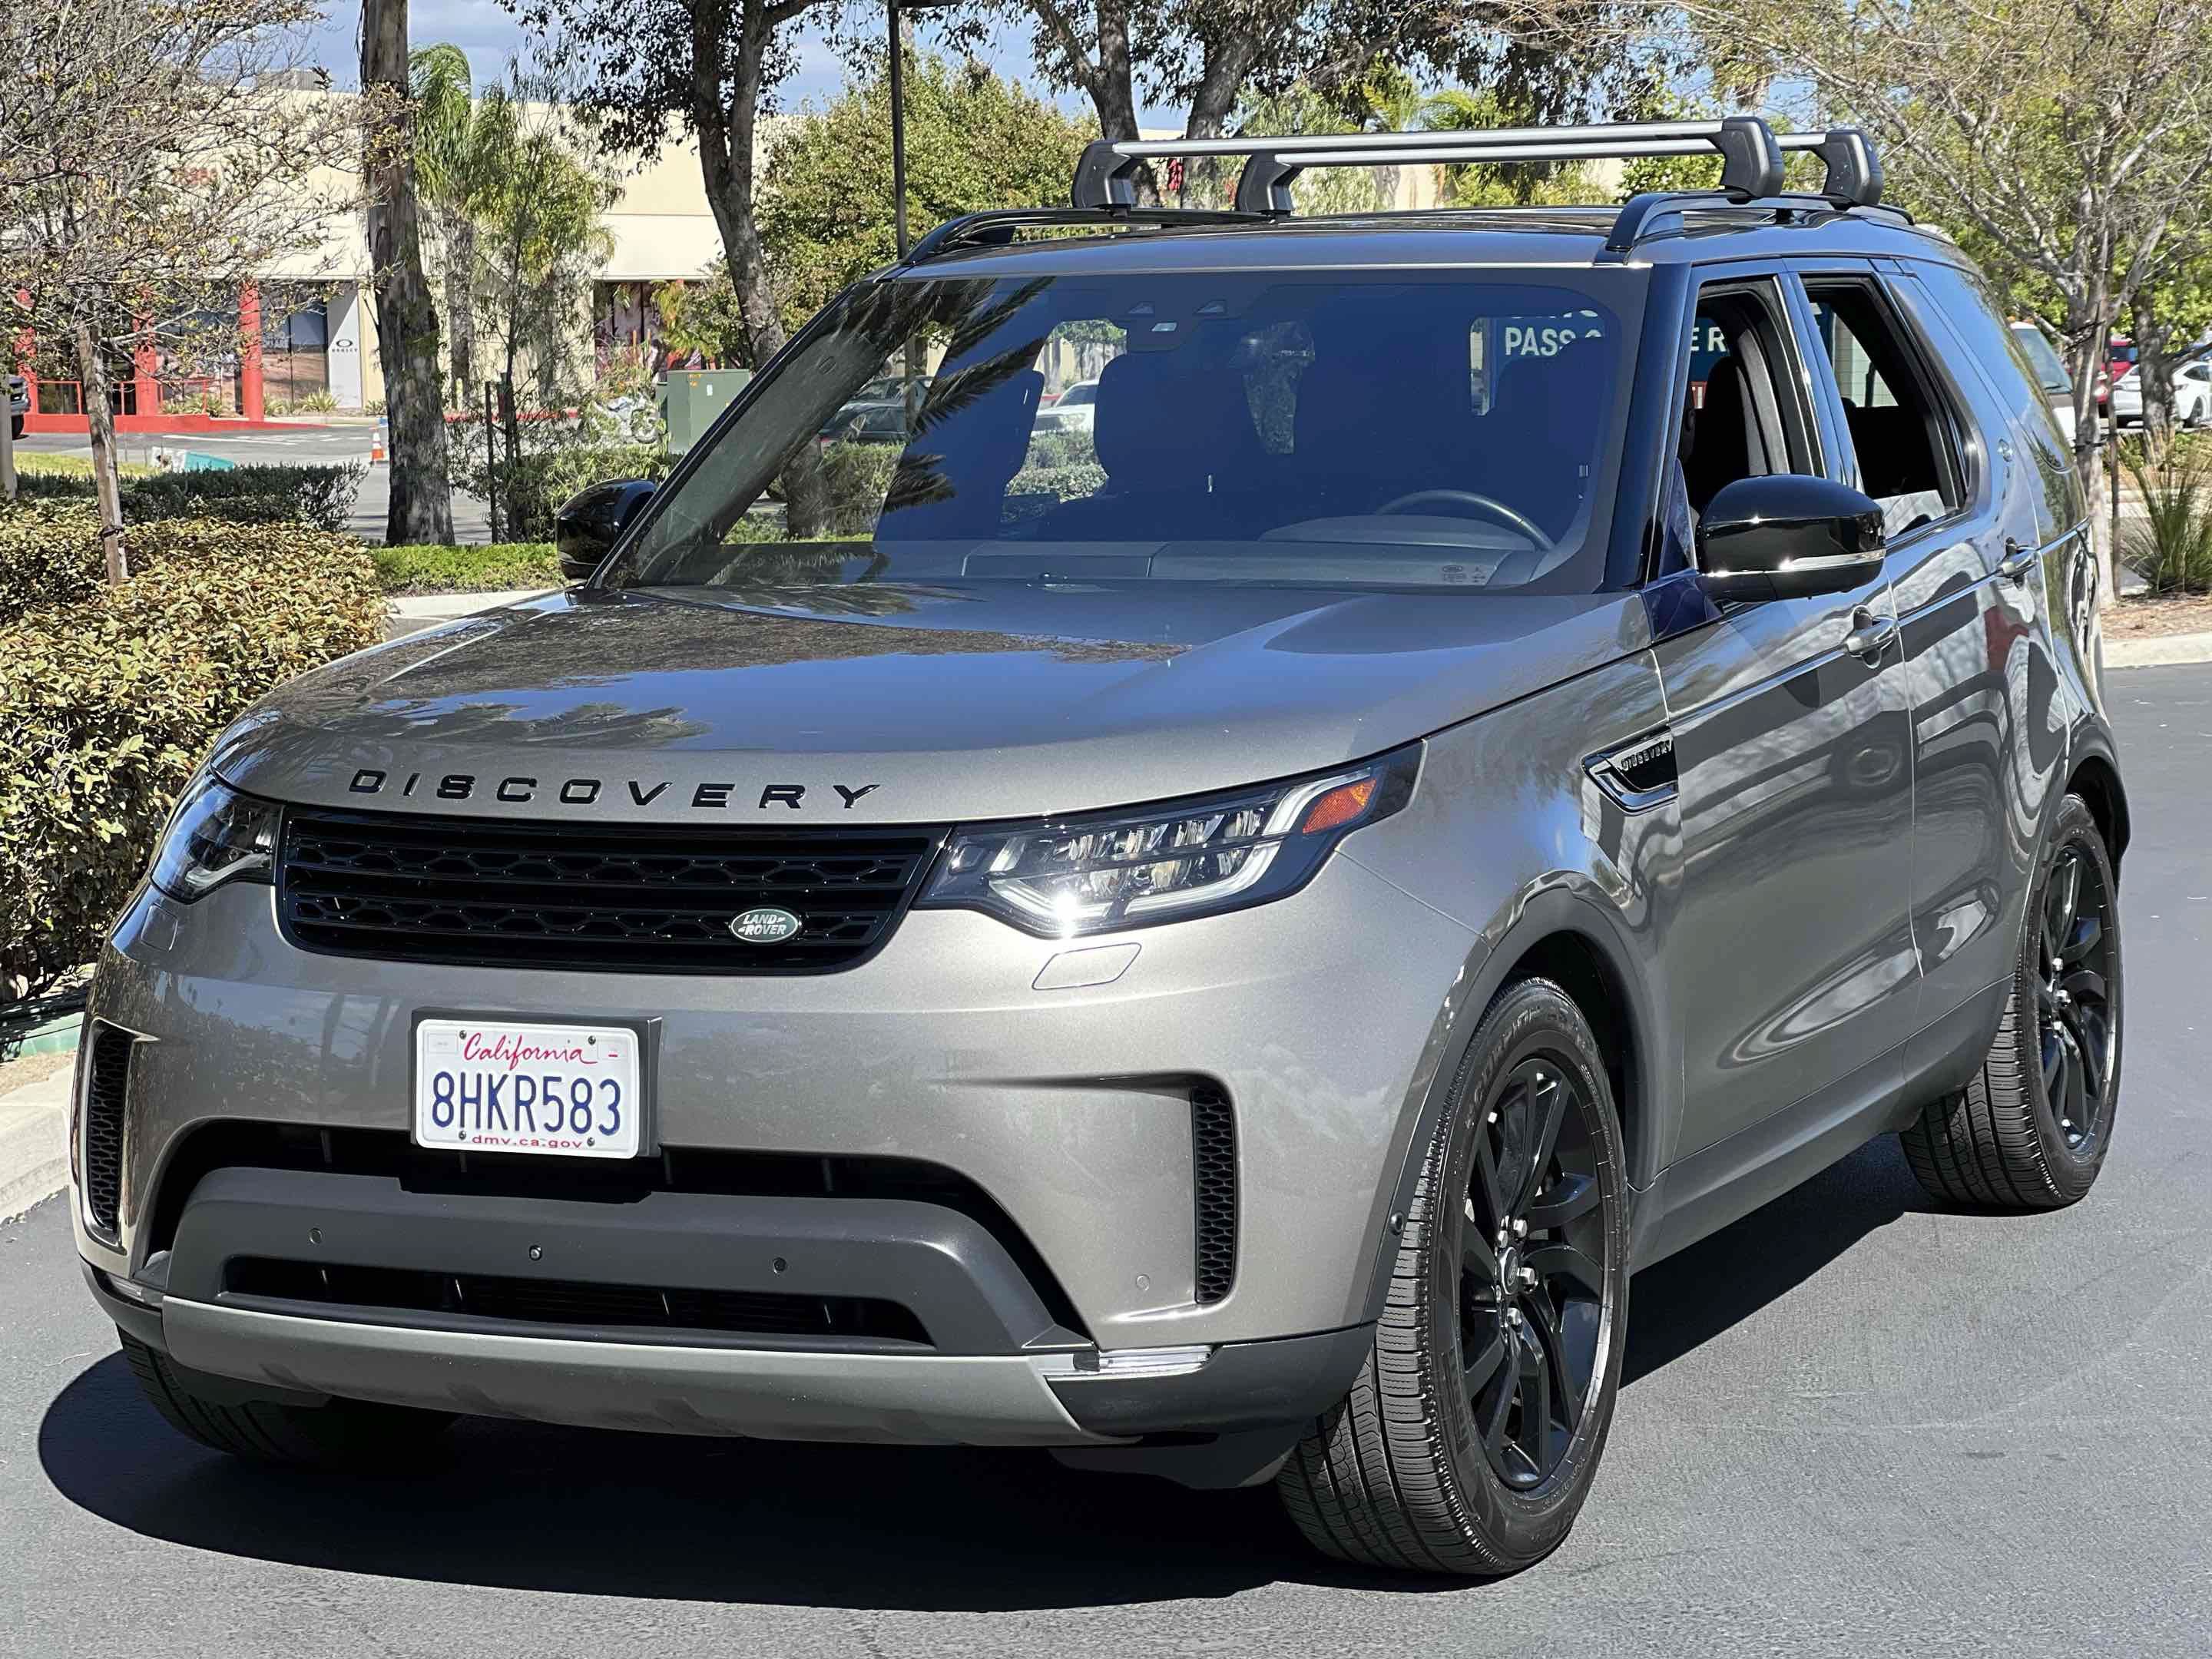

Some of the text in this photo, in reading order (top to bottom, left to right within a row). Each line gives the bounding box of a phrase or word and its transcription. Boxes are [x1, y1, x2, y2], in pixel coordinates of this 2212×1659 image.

[349, 769, 881, 809] DISCOVERY
[743, 914, 777, 925] LAND
[744, 924, 787, 935] ROVER
[463, 1032, 598, 1071] California
[432, 1071, 621, 1136] 8HKR583
[472, 1134, 583, 1149] dmv.ca.gov
